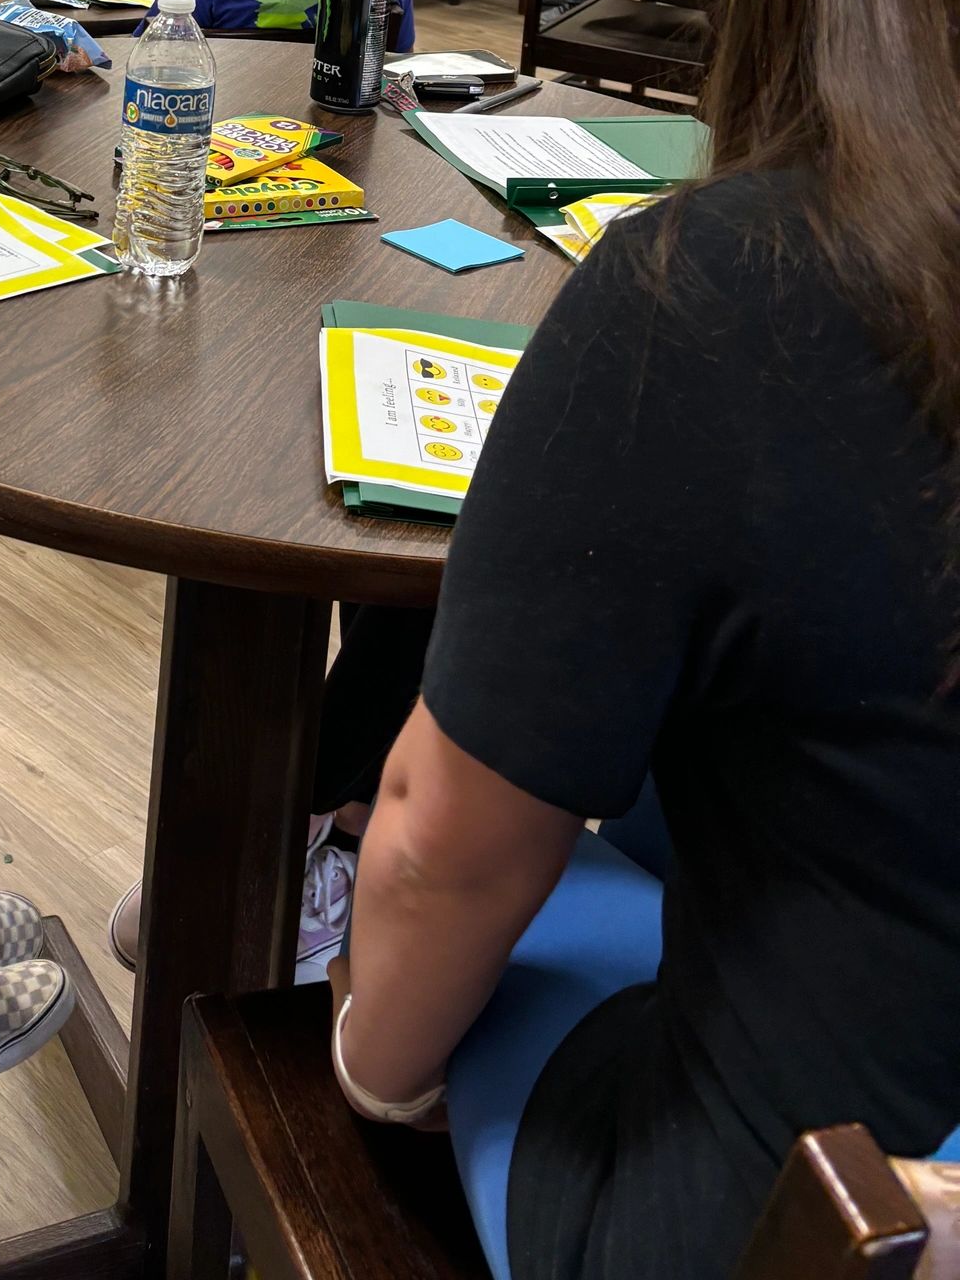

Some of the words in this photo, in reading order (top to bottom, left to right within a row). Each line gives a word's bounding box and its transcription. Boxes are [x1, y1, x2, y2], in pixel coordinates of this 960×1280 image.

[136, 88, 209, 119] niagara
[223, 123, 300, 150] PENCILS
[219, 180, 319, 197] Crayola
[344, 207, 368, 216] 10
[381, 377, 397, 409] feeling...
[387, 409, 397, 422] am
